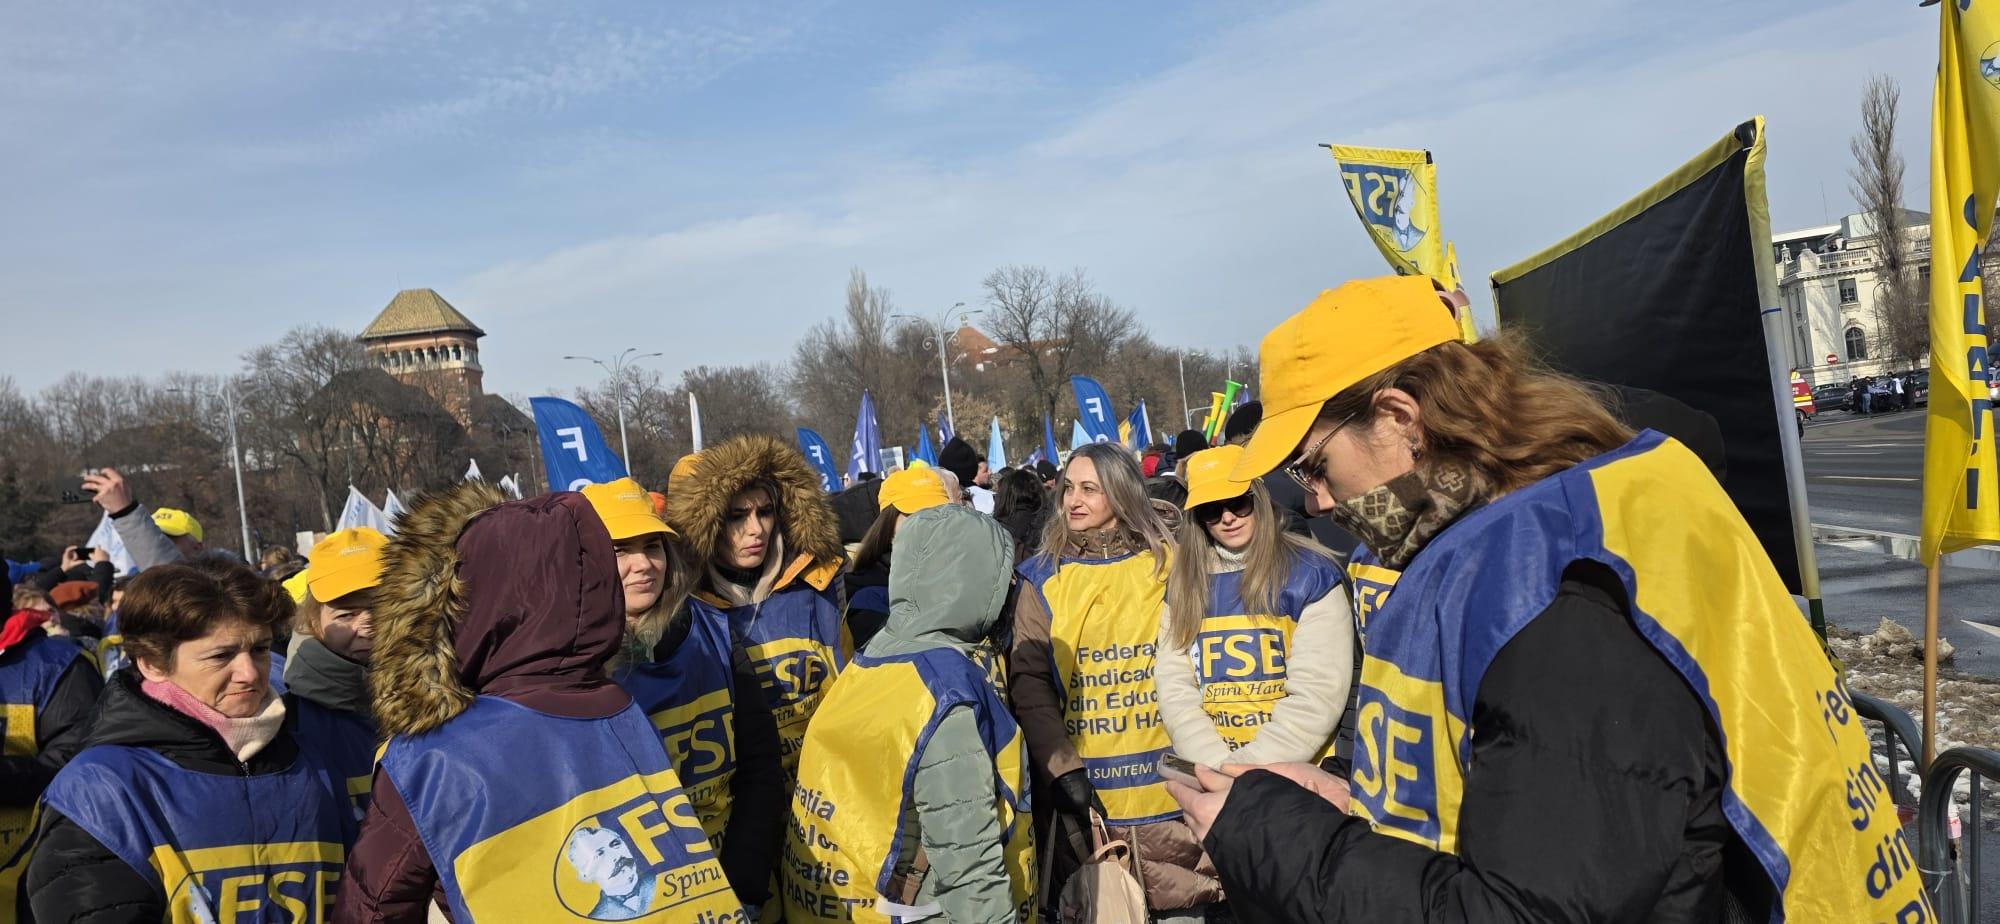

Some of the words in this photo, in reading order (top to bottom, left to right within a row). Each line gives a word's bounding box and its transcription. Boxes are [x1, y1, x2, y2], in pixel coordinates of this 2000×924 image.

[1202, 633, 1286, 678] FSE
[1205, 684, 1242, 700] Spiru
[1070, 694, 1098, 712] din
[1066, 715, 1127, 736] SPIRU
[1094, 762, 1153, 779] SUNTEM
[662, 864, 722, 898] Spiru
